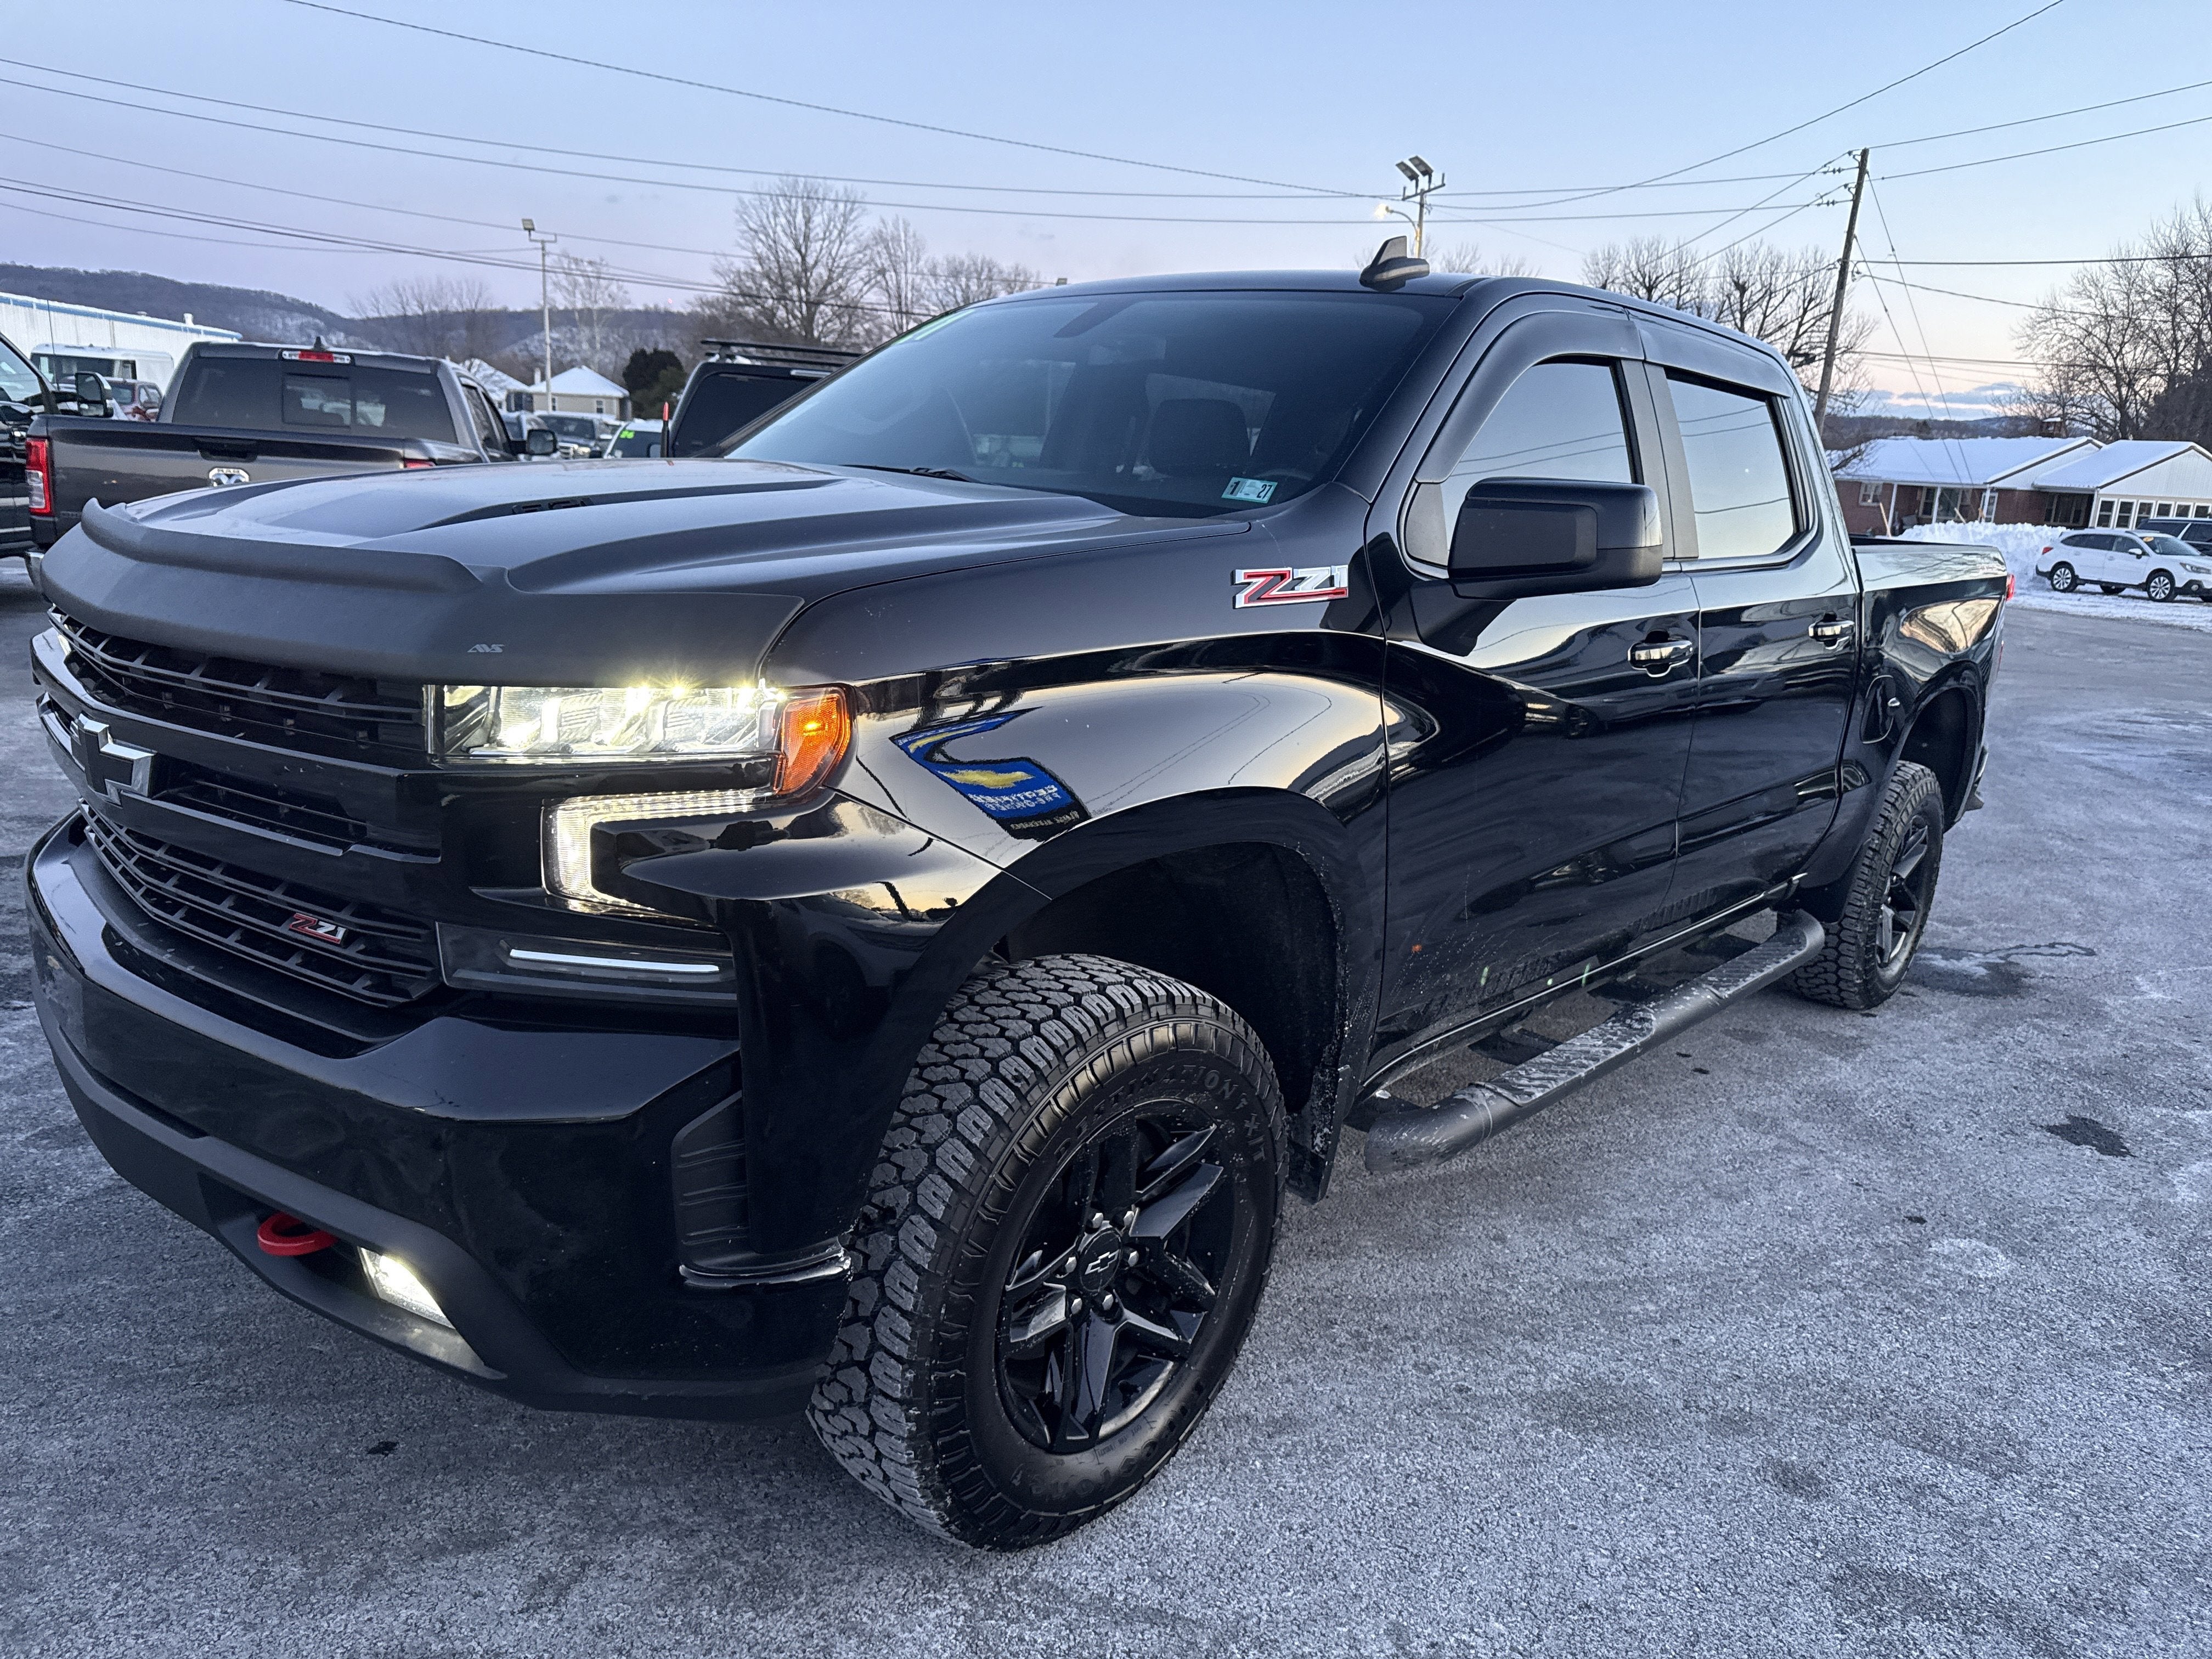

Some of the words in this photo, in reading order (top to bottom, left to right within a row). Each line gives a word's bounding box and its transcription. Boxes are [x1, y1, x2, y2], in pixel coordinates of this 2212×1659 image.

[1229, 481, 1241, 495] 1
[1256, 484, 1273, 500] 27
[1231, 565, 1348, 608] Z71
[467, 644, 505, 652] AVS
[289, 913, 347, 944] Z71
